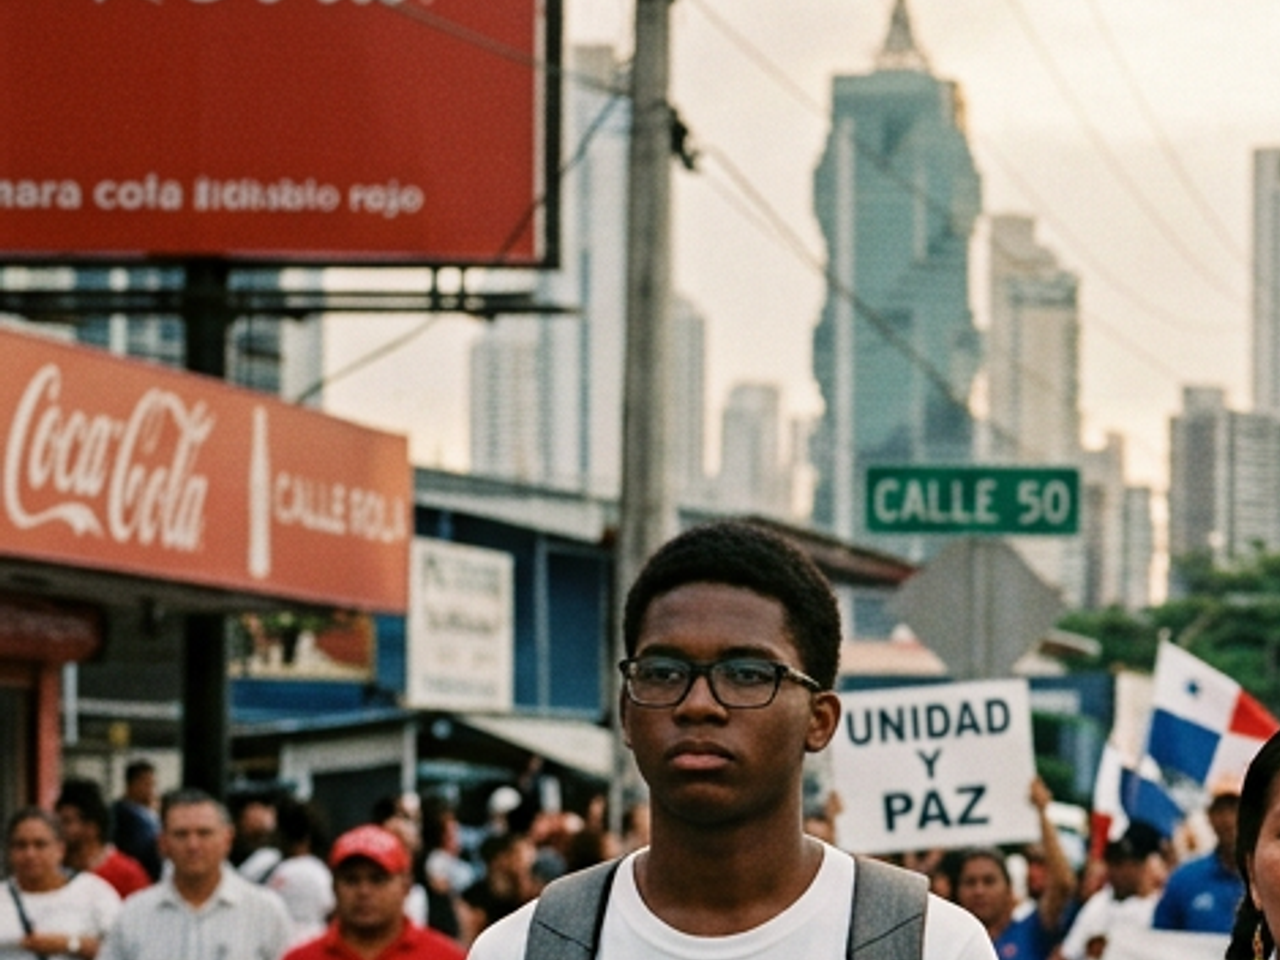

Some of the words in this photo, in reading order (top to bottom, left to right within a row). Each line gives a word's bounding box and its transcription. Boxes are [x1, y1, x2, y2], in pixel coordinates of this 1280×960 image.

[275, 471, 346, 536] CALLE
[872, 477, 1000, 525] CALLE
[1016, 478, 1072, 526] 50
[846, 698, 1011, 745] UNIDAD
[916, 748, 941, 779] Y
[883, 784, 990, 832] PAZ
